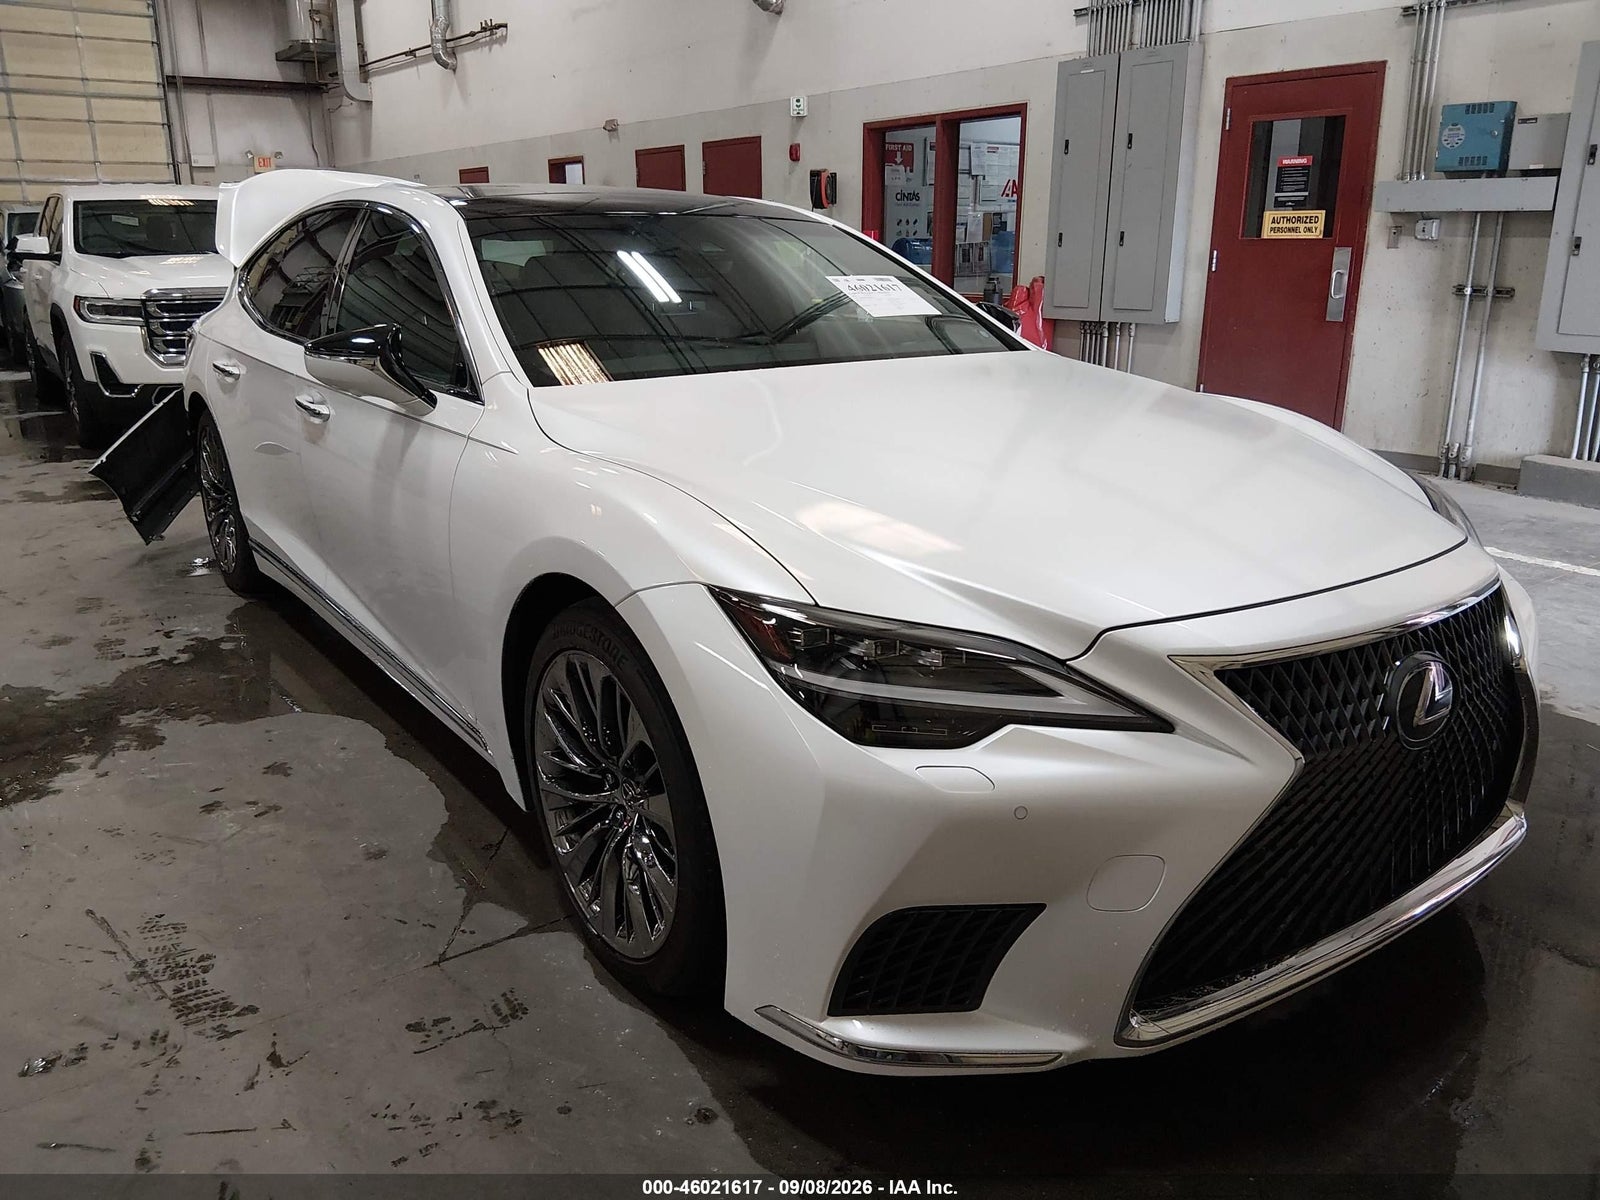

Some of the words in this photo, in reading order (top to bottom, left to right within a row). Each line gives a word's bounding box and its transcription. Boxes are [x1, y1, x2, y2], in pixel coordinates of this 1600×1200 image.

[257, 156, 272, 168] EXIT
[895, 189, 920, 202] CINTAS
[1271, 216, 1319, 225] AUTHORIZED
[1269, 226, 1302, 234] PERSONNEL
[1303, 226, 1318, 234] ONLY
